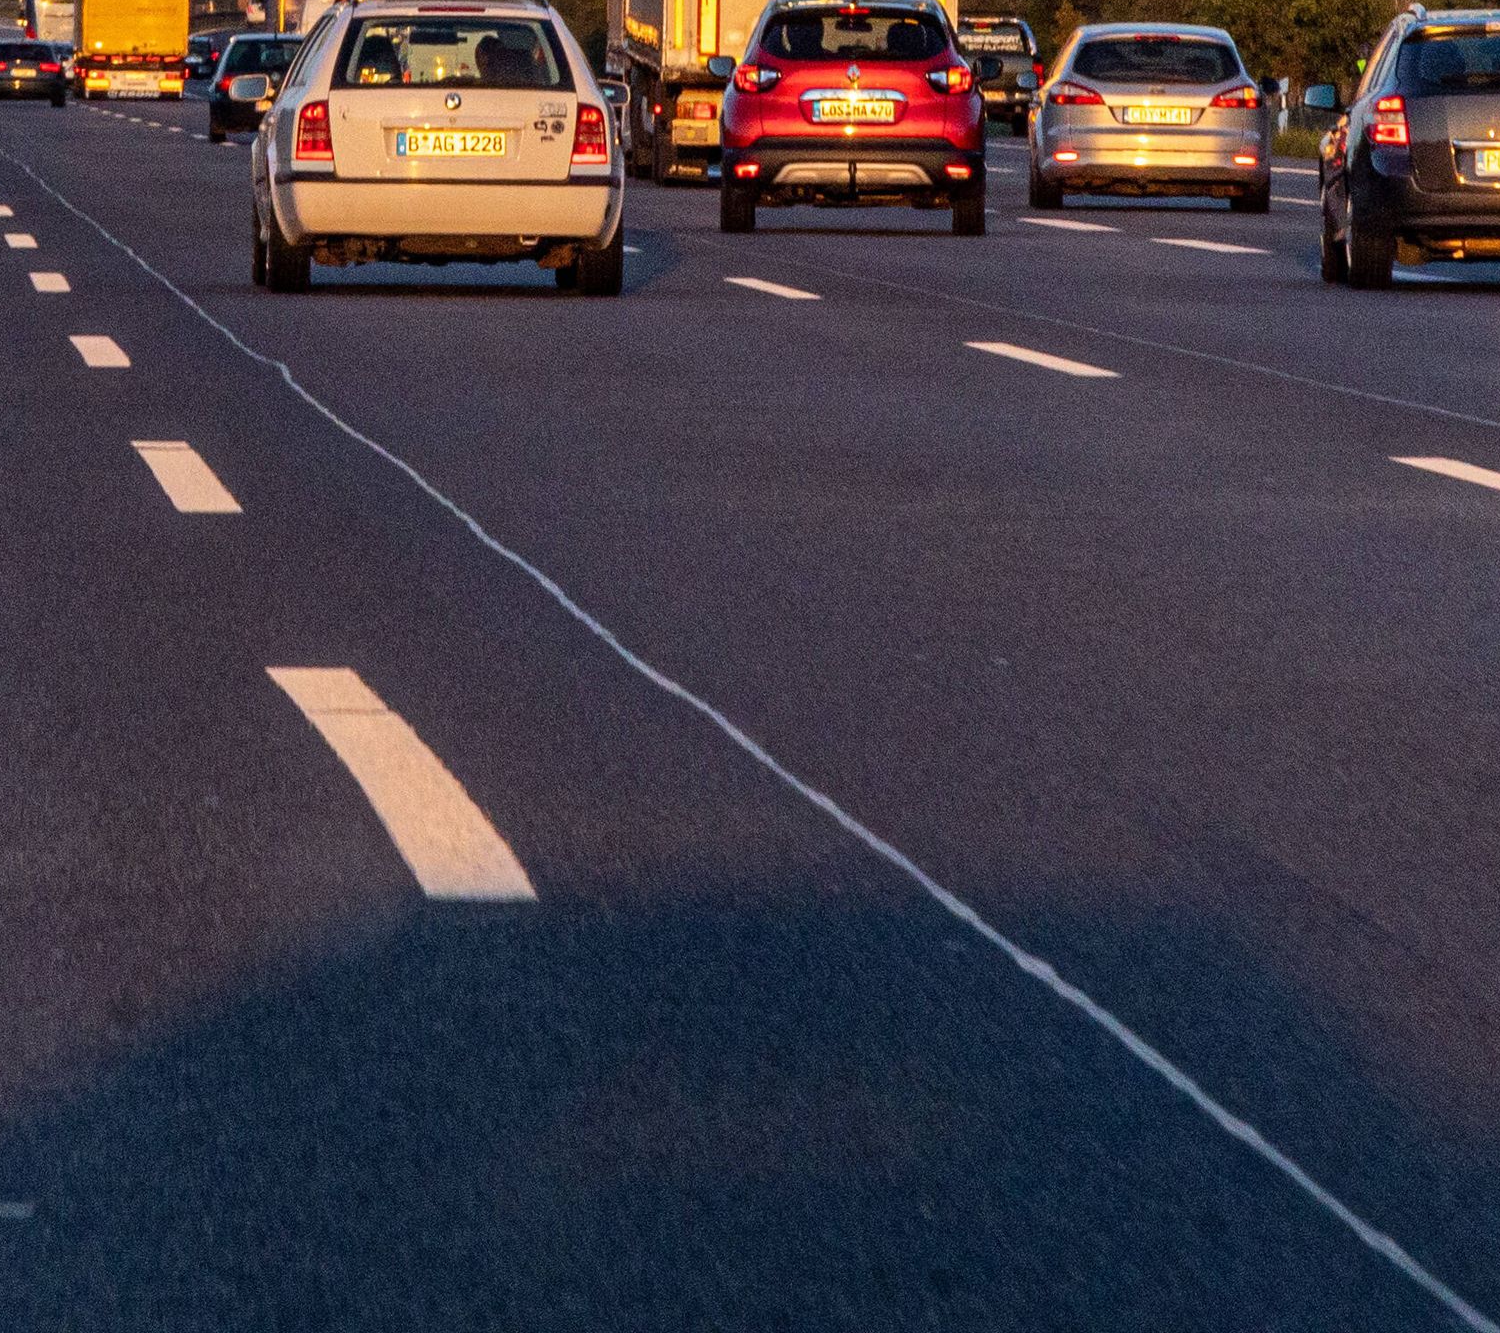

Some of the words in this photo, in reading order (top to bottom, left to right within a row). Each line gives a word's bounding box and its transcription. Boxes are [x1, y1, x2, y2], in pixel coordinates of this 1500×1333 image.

[822, 106, 844, 116] LOS
[871, 106, 892, 116] 470
[408, 135, 419, 152] B
[432, 135, 454, 152] AG
[460, 135, 503, 152] 1228
